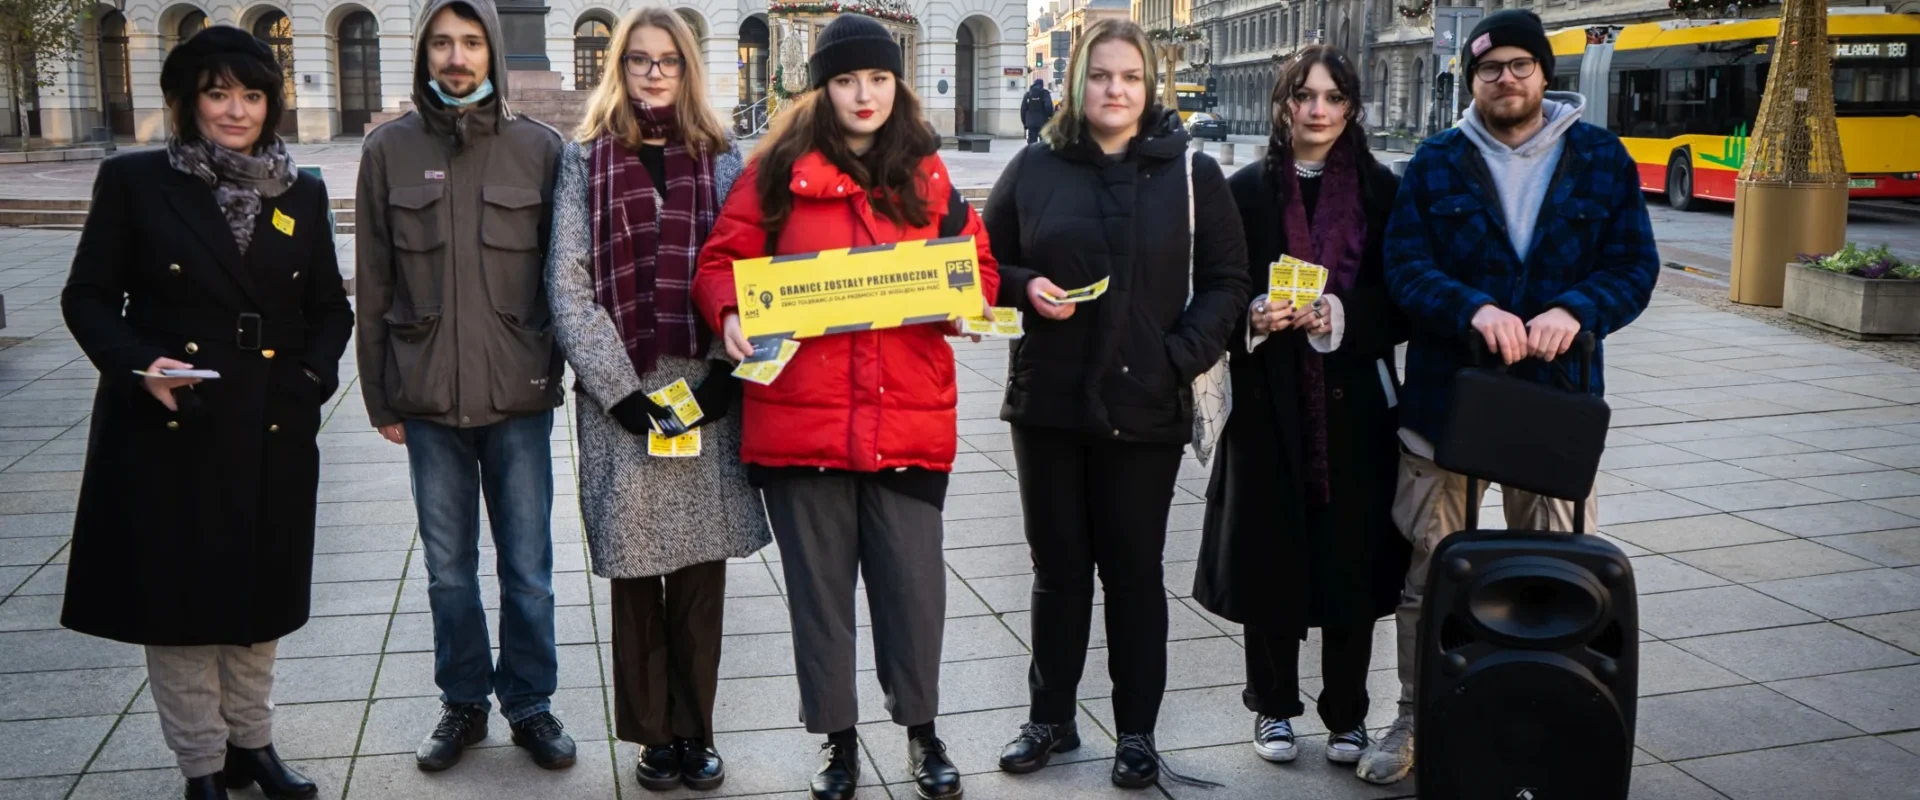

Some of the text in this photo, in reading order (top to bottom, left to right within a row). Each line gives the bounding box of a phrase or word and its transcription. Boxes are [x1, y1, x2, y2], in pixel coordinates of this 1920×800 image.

[1836, 43, 1907, 57] WILANÓW 180
[947, 261, 972, 274] PES
[780, 269, 938, 296] GRANICE ZOSTAŁY PRZEKROCZONE
[798, 296, 833, 306] TOLERANCJI
[847, 292, 878, 300] PRZEMOCY
